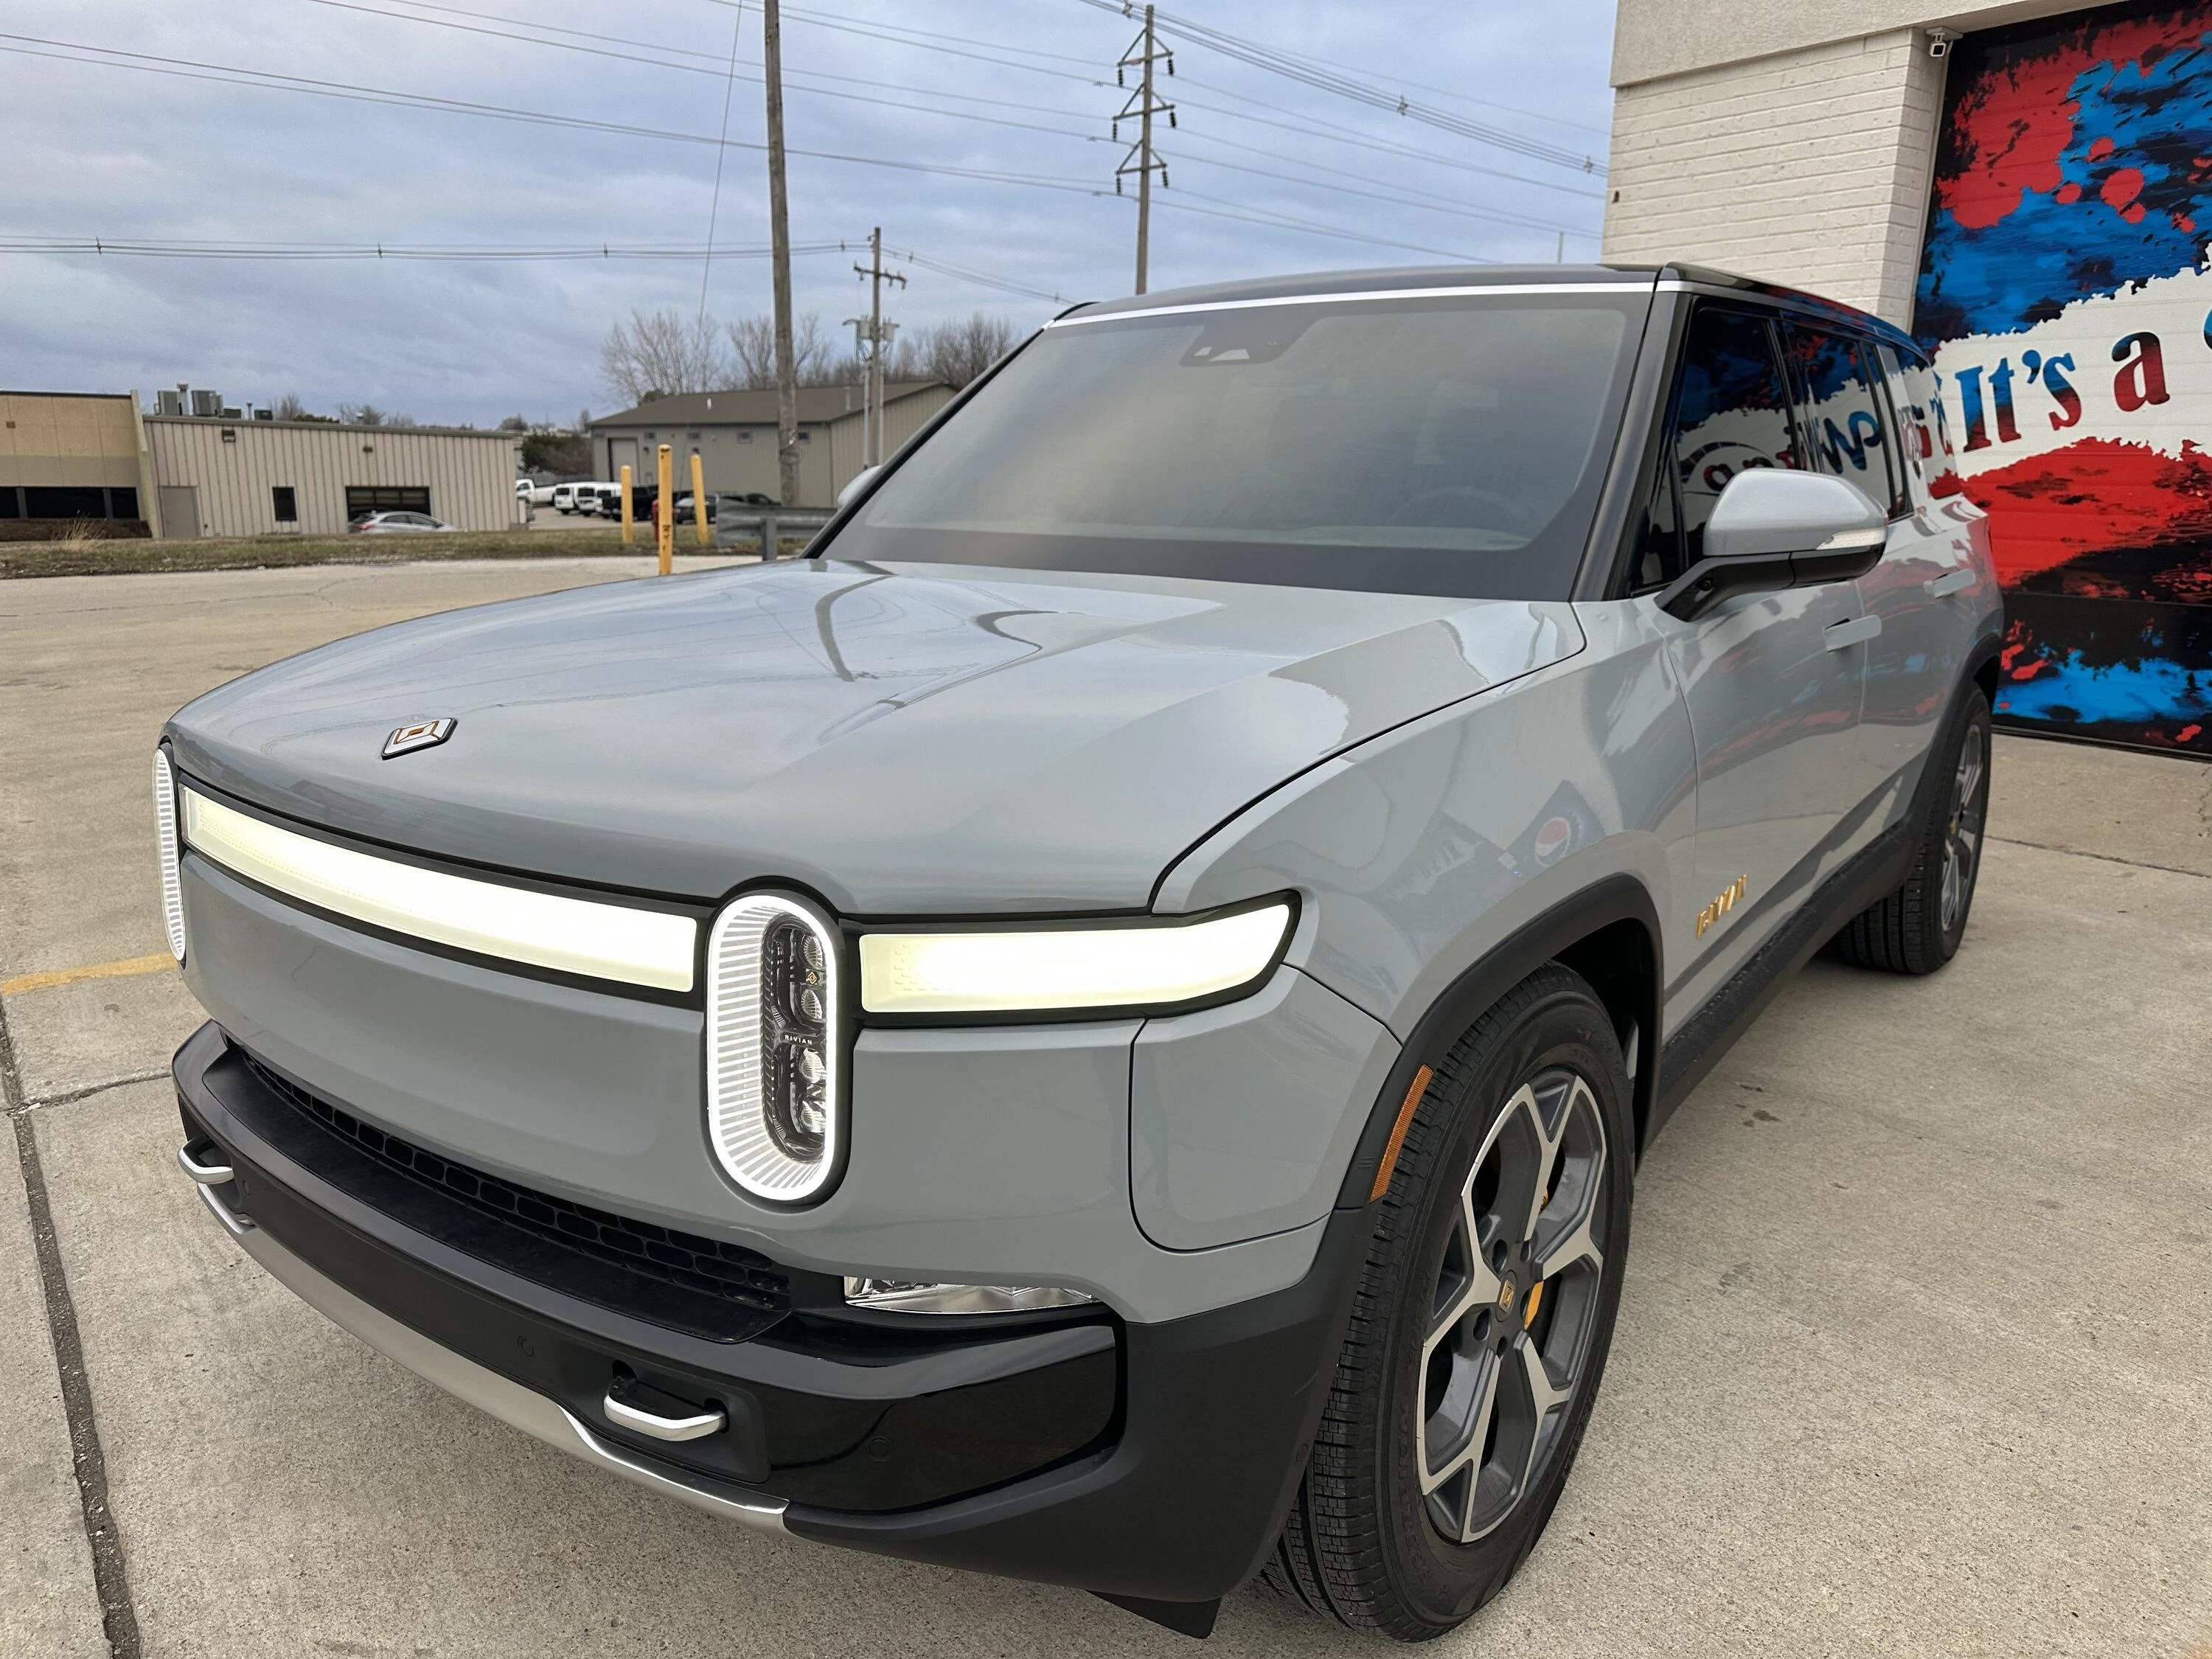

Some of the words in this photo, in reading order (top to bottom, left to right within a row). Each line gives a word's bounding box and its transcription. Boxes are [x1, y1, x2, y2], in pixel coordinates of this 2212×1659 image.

[1955, 349, 2082, 453] It's
[2111, 331, 2171, 412] a
[785, 1034, 813, 1046] RIVIAN
